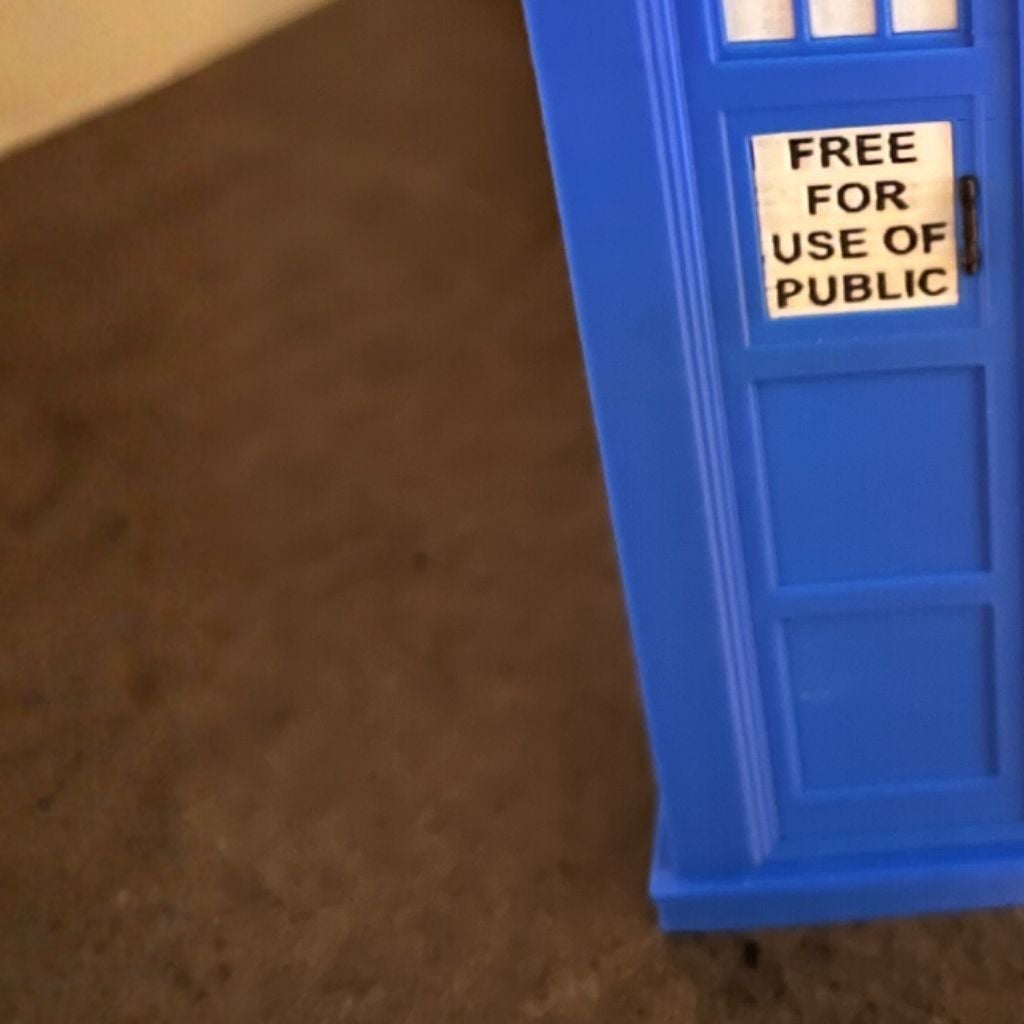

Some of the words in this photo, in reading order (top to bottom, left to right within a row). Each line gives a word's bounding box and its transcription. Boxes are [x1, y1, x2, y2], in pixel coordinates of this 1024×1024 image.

[788, 131, 918, 170] FREE
[807, 180, 909, 216] FOR
[771, 228, 868, 265] USE
[883, 222, 948, 256] OF
[775, 268, 948, 309] PUBLIC
